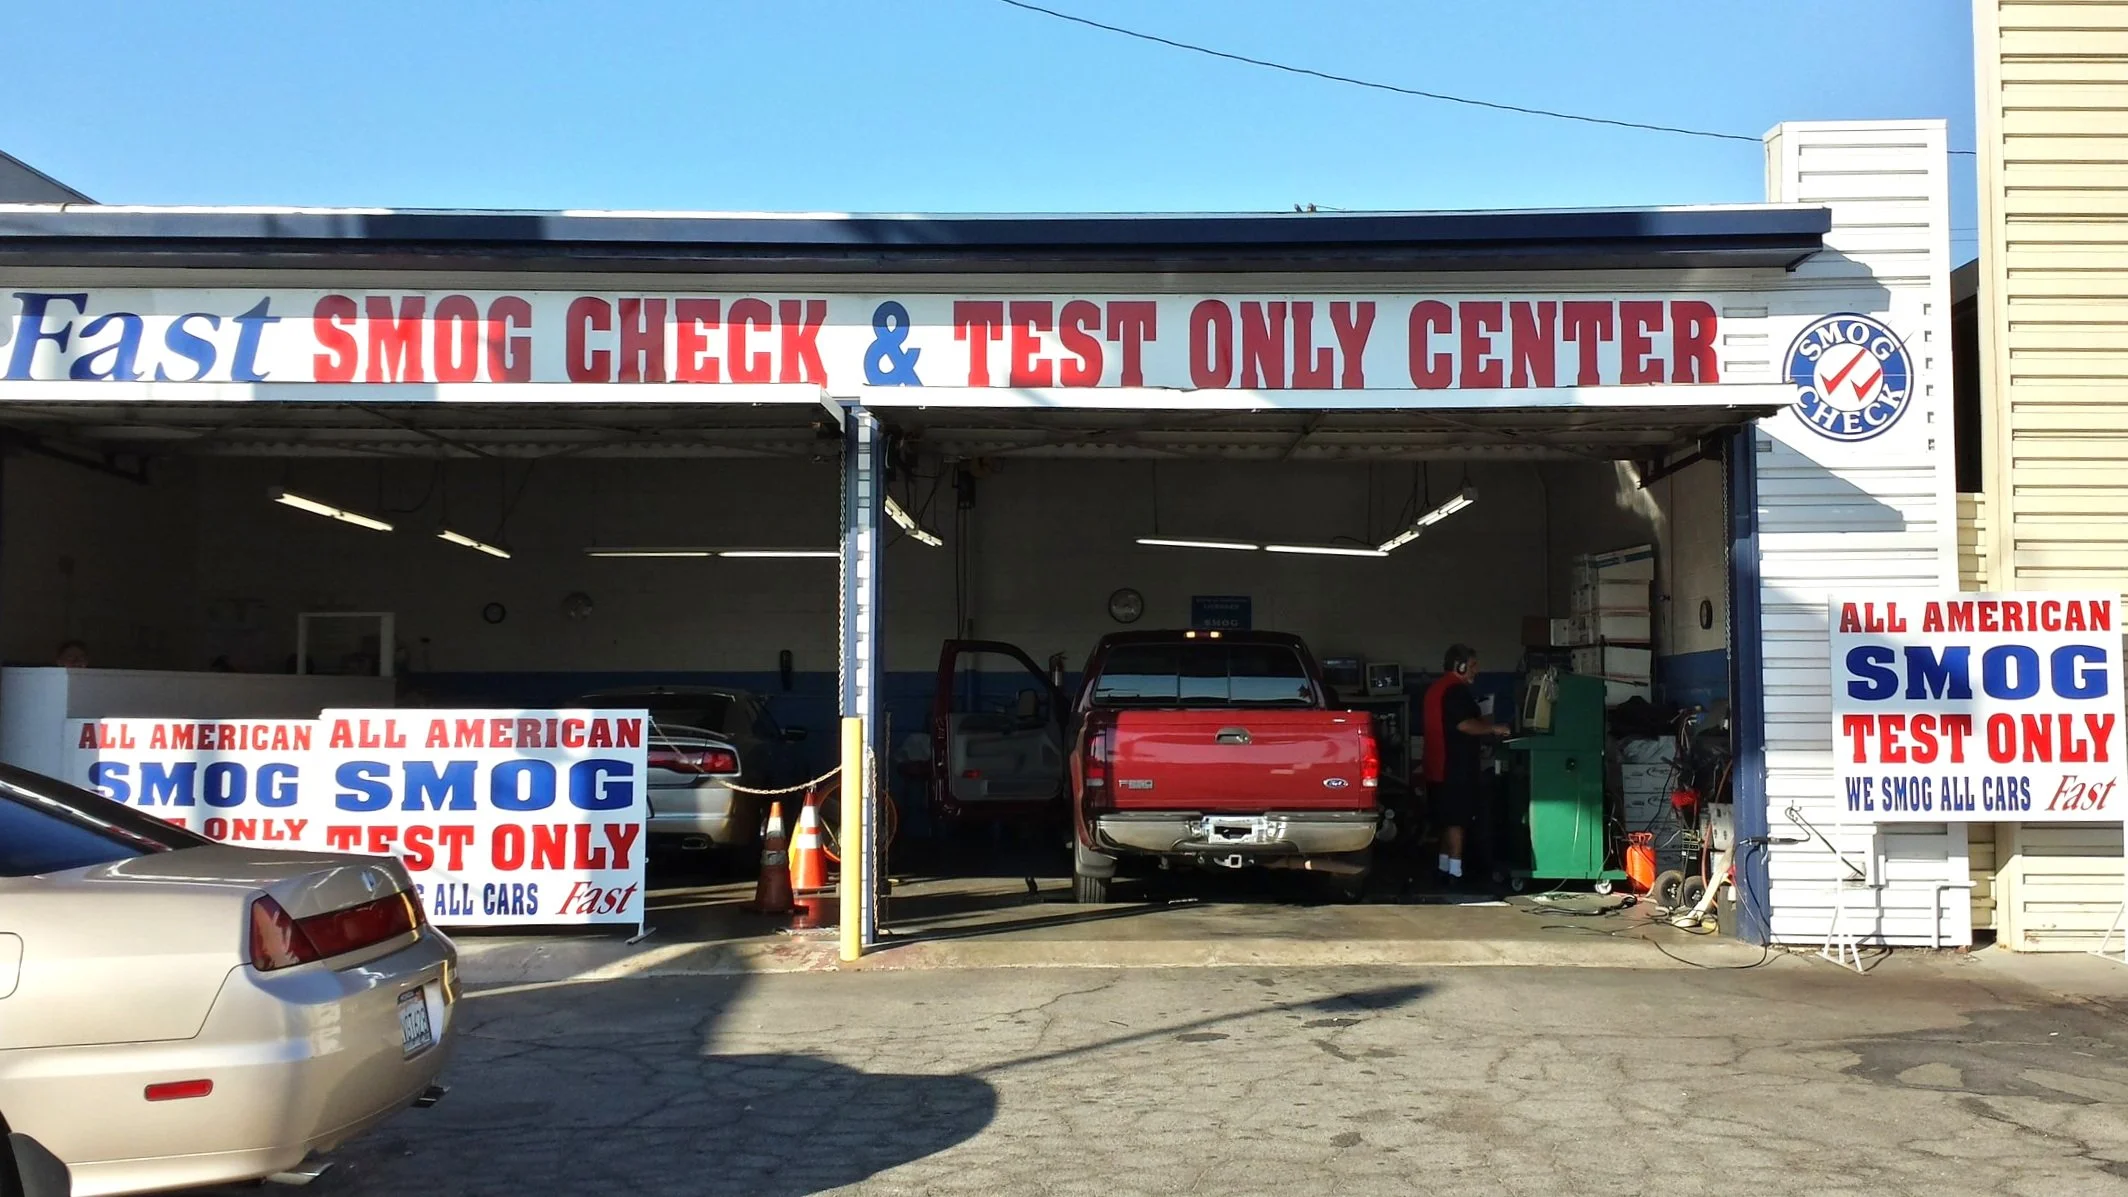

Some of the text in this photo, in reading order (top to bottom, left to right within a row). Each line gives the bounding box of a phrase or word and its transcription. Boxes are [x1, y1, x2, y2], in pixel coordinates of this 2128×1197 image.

[3, 292, 1719, 388] Fast SMOG CHECK & TEST ONLY CENTER
[1798, 320, 1896, 361] SMOG
[1795, 383, 1905, 433] CHECK
[1839, 600, 2111, 633] ALL AMERICAN
[1845, 644, 2109, 701] SMOG
[78, 723, 312, 751] ALL AMERICAN
[329, 718, 642, 748] ALL AMERICAN
[1842, 713, 2115, 763] TEST ONLY
[88, 761, 299, 808] SMOG
[335, 759, 634, 812] SMOG
[1845, 774, 2118, 812] WE SMOG ALL CARS Fast
[204, 817, 308, 841] ONLY
[491, 823, 640, 871] ONLY
[434, 883, 473, 915] ALL
[483, 882, 539, 915] CARS
[555, 881, 638, 915] Fast
